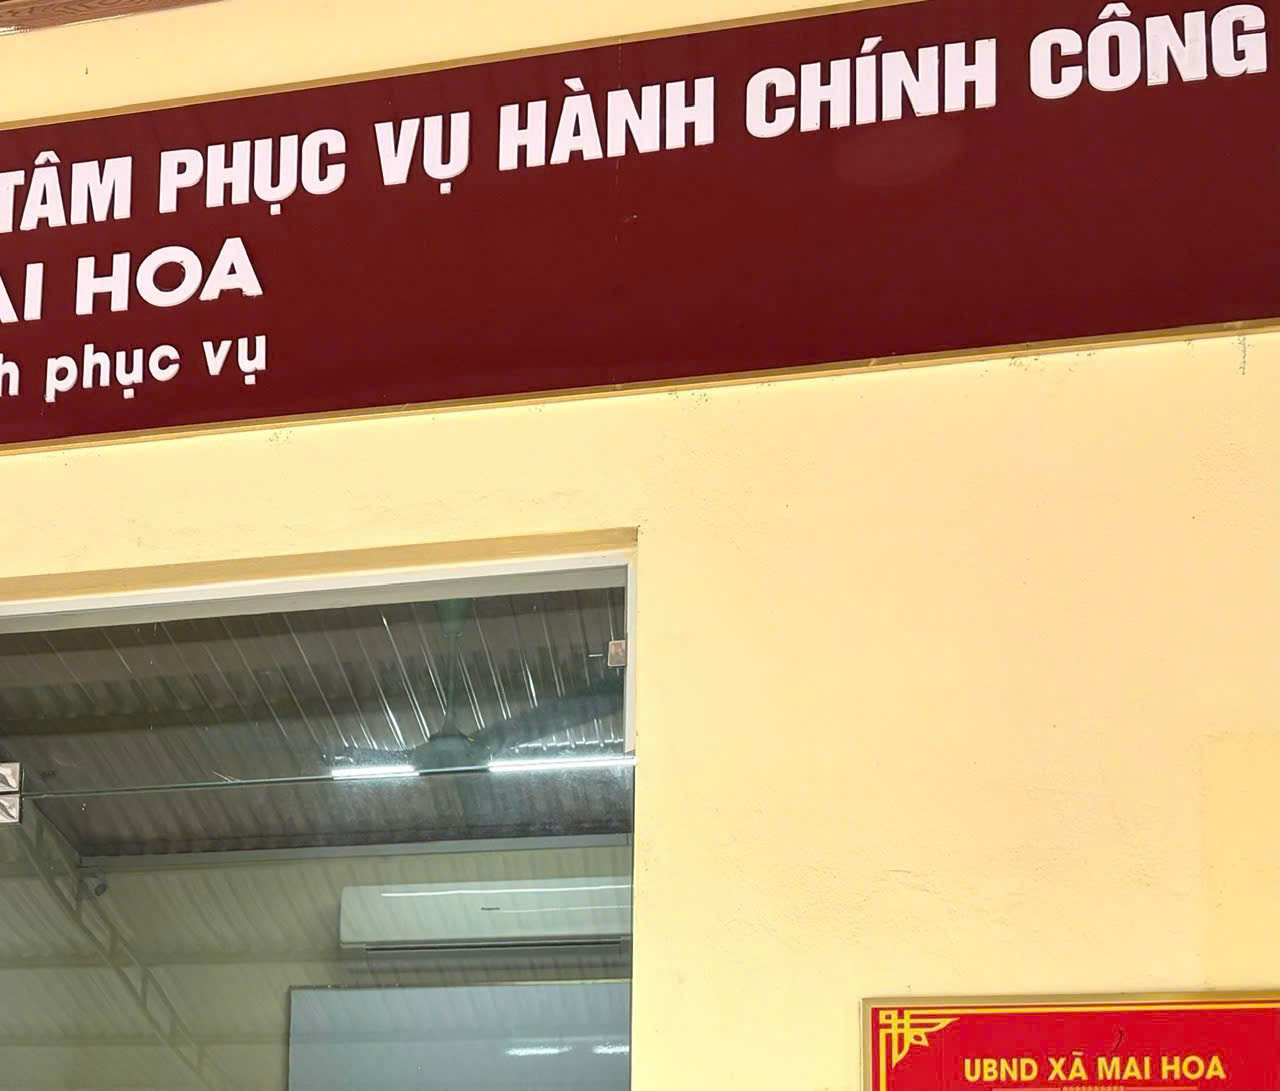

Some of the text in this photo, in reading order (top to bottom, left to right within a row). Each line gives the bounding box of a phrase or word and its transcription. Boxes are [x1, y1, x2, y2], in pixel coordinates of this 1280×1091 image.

[159, 130, 346, 216] PHỤC
[374, 112, 470, 194] VỤ
[499, 77, 715, 171] HÀNH
[746, 36, 997, 139] CHÍNH
[1029, 3, 1268, 100] CÔNG
[76, 237, 263, 316] HOA
[44, 343, 180, 402] phục
[202, 335, 267, 385] vụ
[964, 1050, 1226, 1082] UBND XÃ MAI HOA
